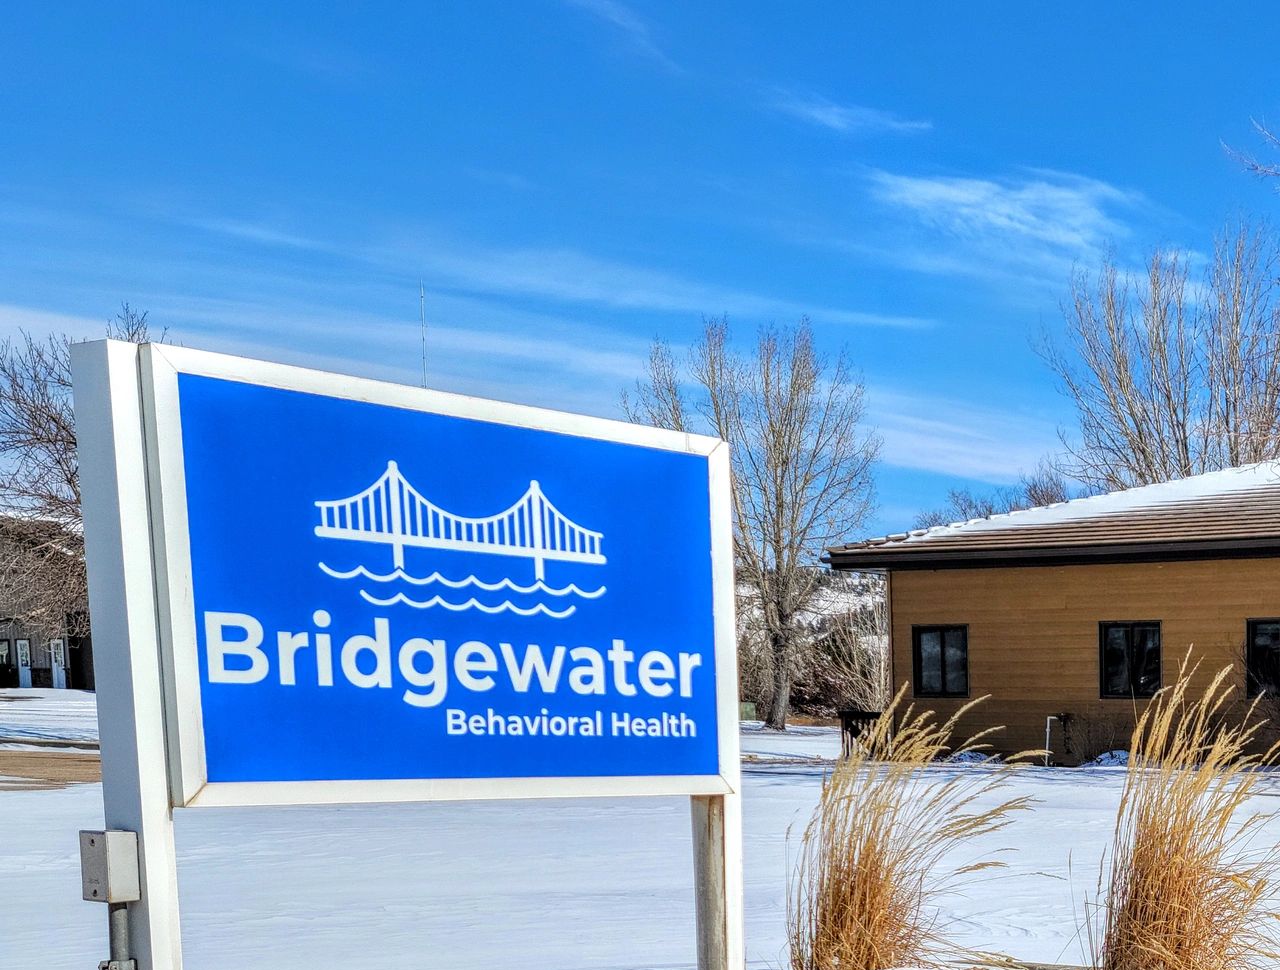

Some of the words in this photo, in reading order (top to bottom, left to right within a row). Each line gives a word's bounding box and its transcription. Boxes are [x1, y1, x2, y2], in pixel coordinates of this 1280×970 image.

[203, 609, 702, 708] Bridgewater
[446, 708, 603, 736] Behavioral
[611, 711, 697, 738] Health
